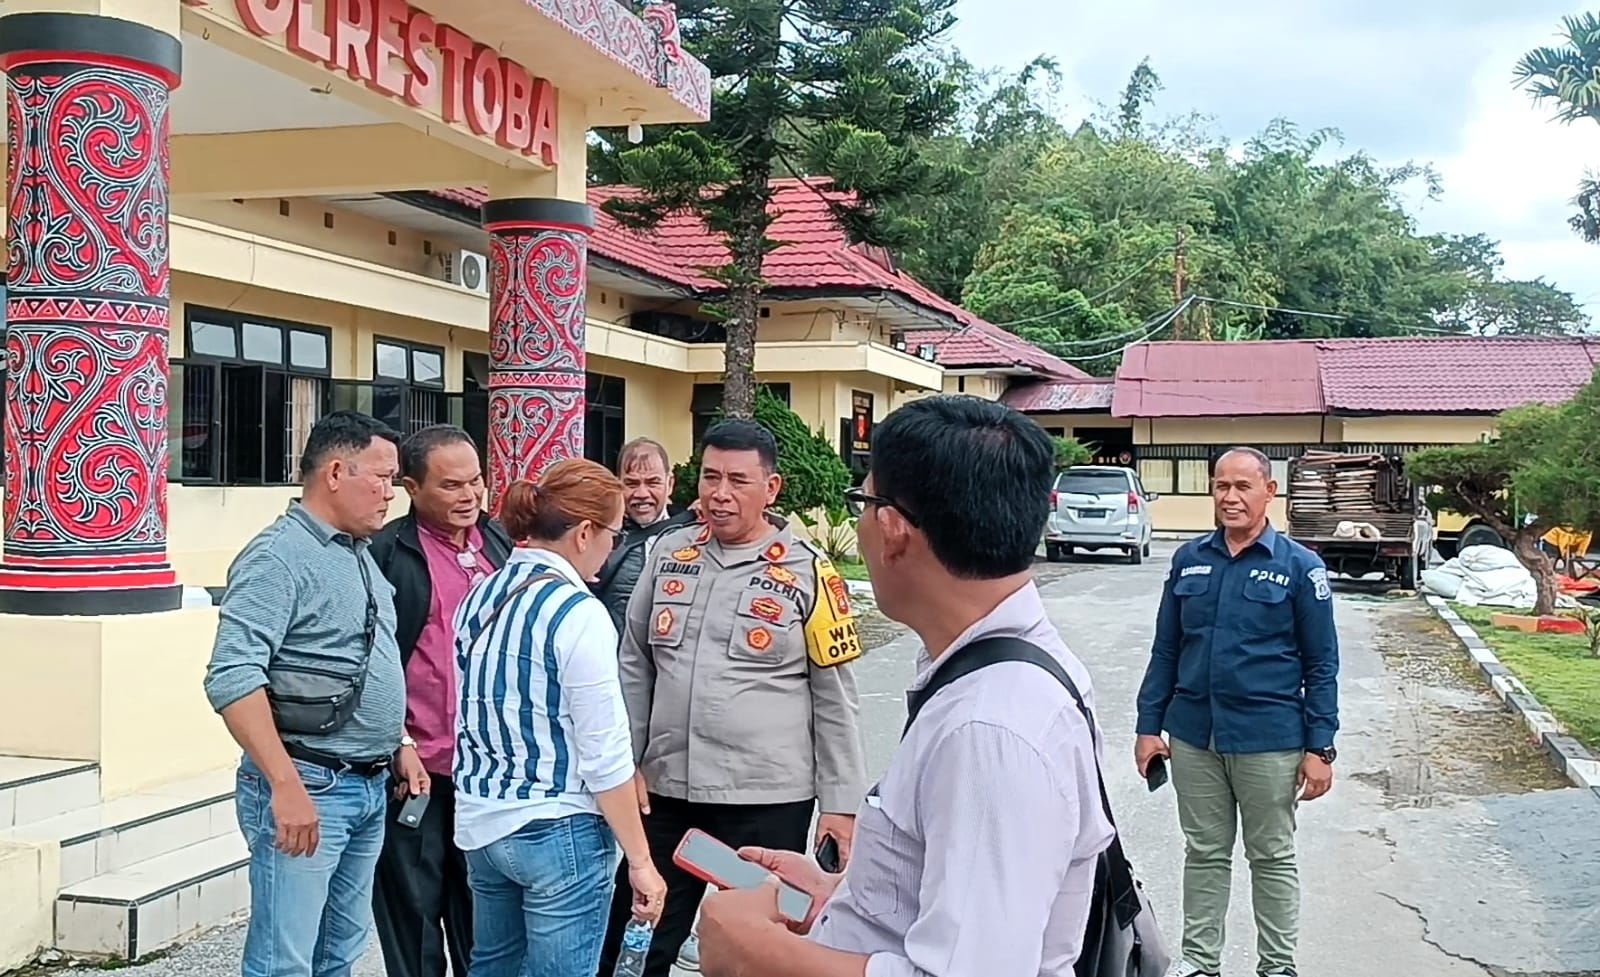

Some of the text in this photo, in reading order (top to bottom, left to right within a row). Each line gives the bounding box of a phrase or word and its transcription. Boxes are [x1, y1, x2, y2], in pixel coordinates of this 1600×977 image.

[1250, 569, 1290, 586] POLRI
[749, 576, 797, 601] POLRI
[829, 622, 858, 642] WA
[828, 639, 857, 658] OPS
